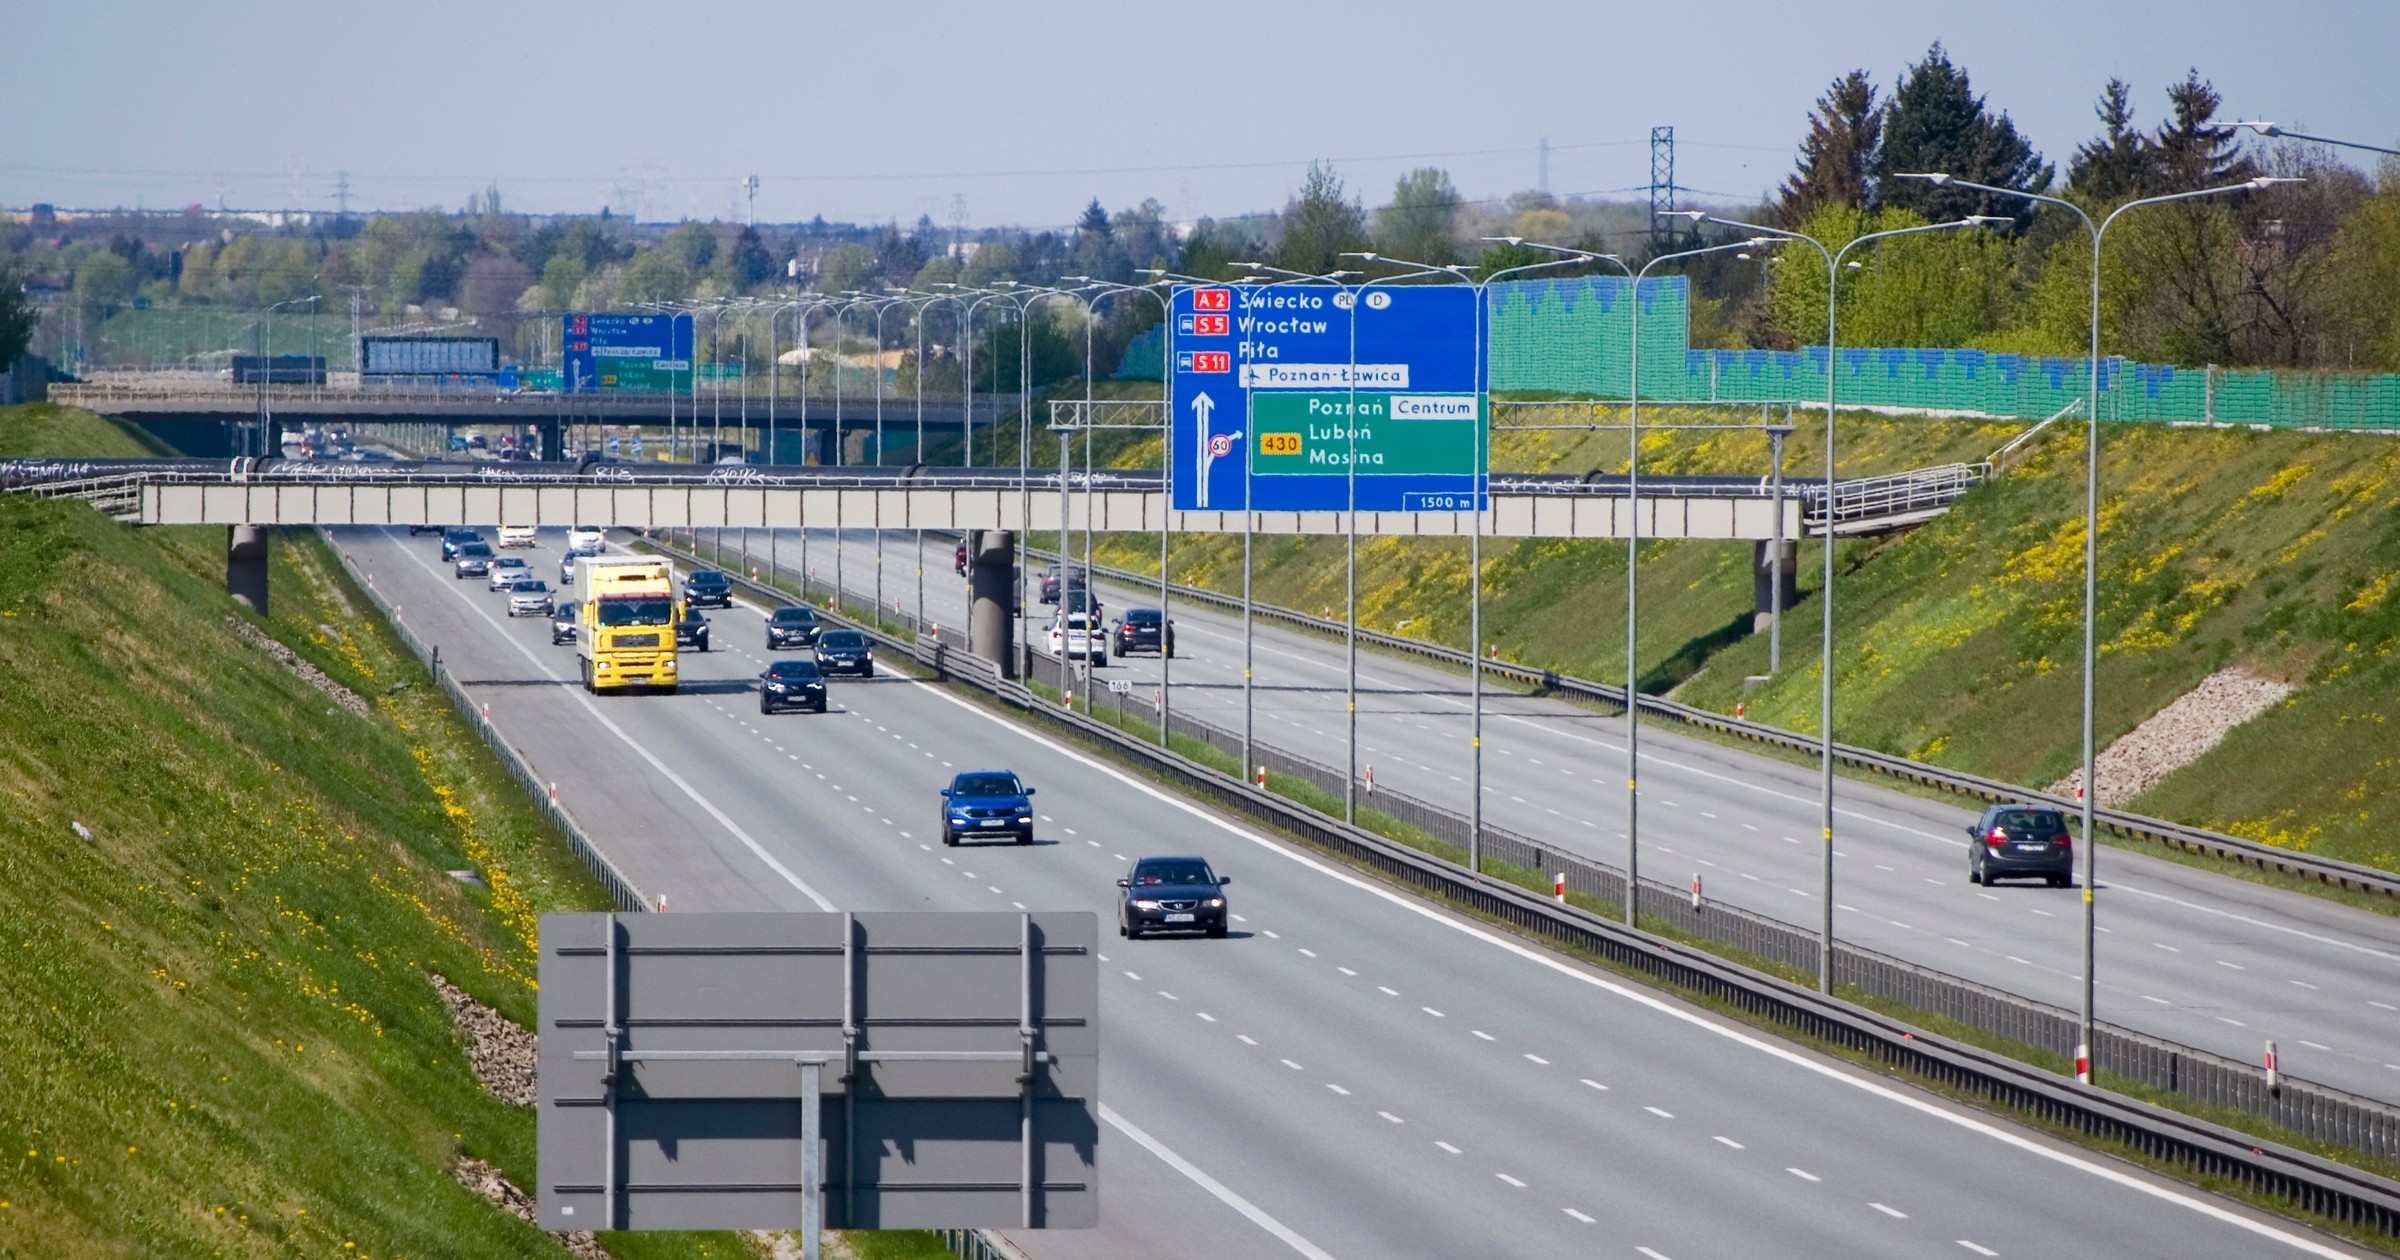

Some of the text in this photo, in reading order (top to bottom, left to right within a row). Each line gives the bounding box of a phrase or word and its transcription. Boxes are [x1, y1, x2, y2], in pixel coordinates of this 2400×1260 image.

[1238, 287, 1323, 309] Świecko
[1373, 295, 1383, 306] D
[1238, 317, 1327, 333] Wrocław
[1238, 341, 1278, 358] Piła
[1269, 367, 1400, 382] Poznań-Ławica
[1309, 398, 1470, 415] Poznań Centrum
[1309, 423, 1371, 440] Luboń
[1212, 440, 1228, 451] 60
[1265, 437, 1297, 451] 430
[1309, 448, 1384, 465] Mosina
[1421, 497, 1470, 508] 1500 m
